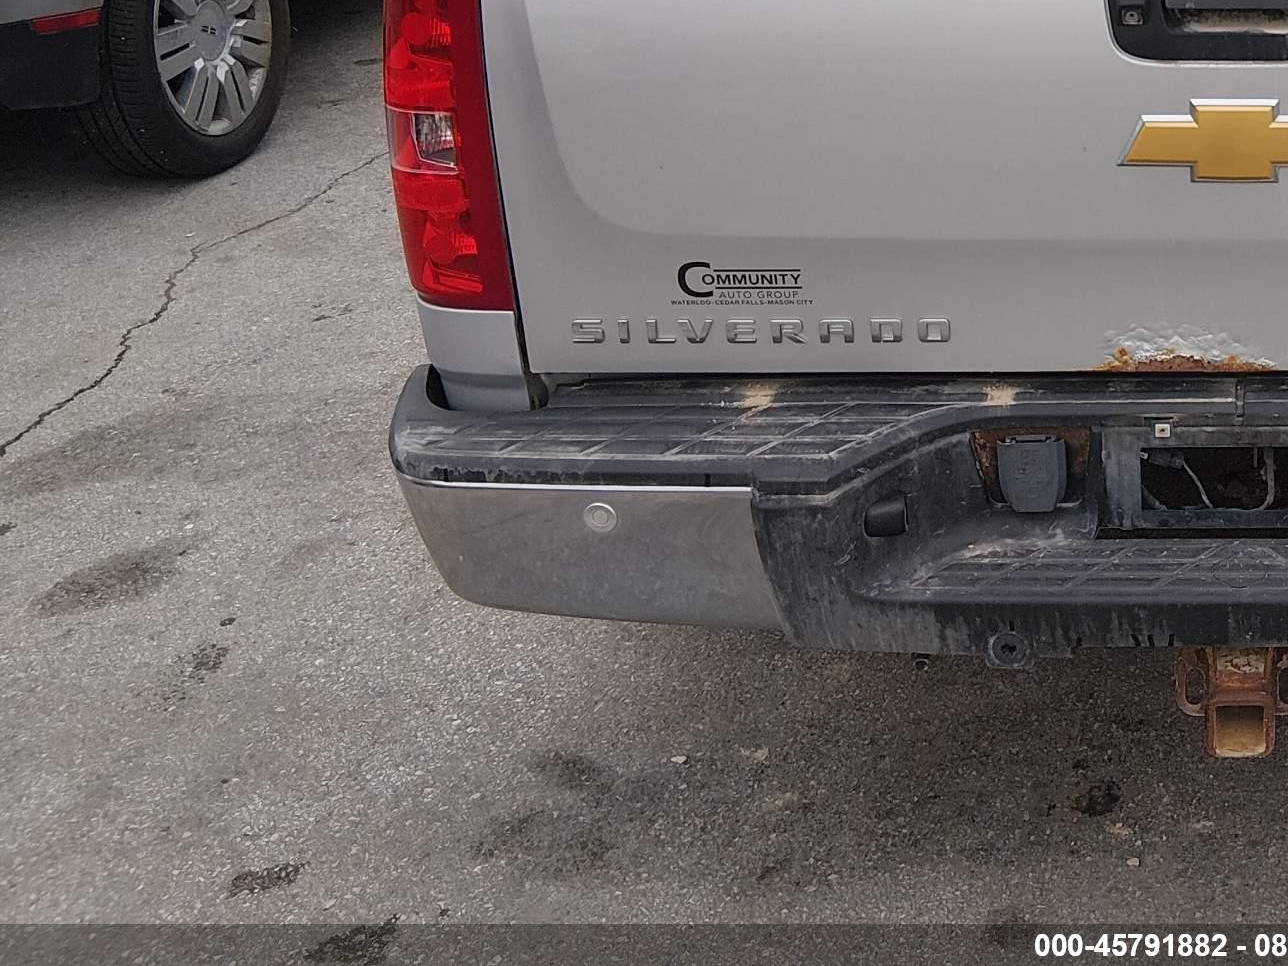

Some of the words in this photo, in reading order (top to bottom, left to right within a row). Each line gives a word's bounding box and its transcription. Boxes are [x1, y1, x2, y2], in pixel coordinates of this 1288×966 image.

[677, 261, 802, 298] COMMUNITY
[718, 290, 752, 299] AUTO
[756, 290, 799, 299] GROUP
[571, 317, 952, 345] SILVERADO
